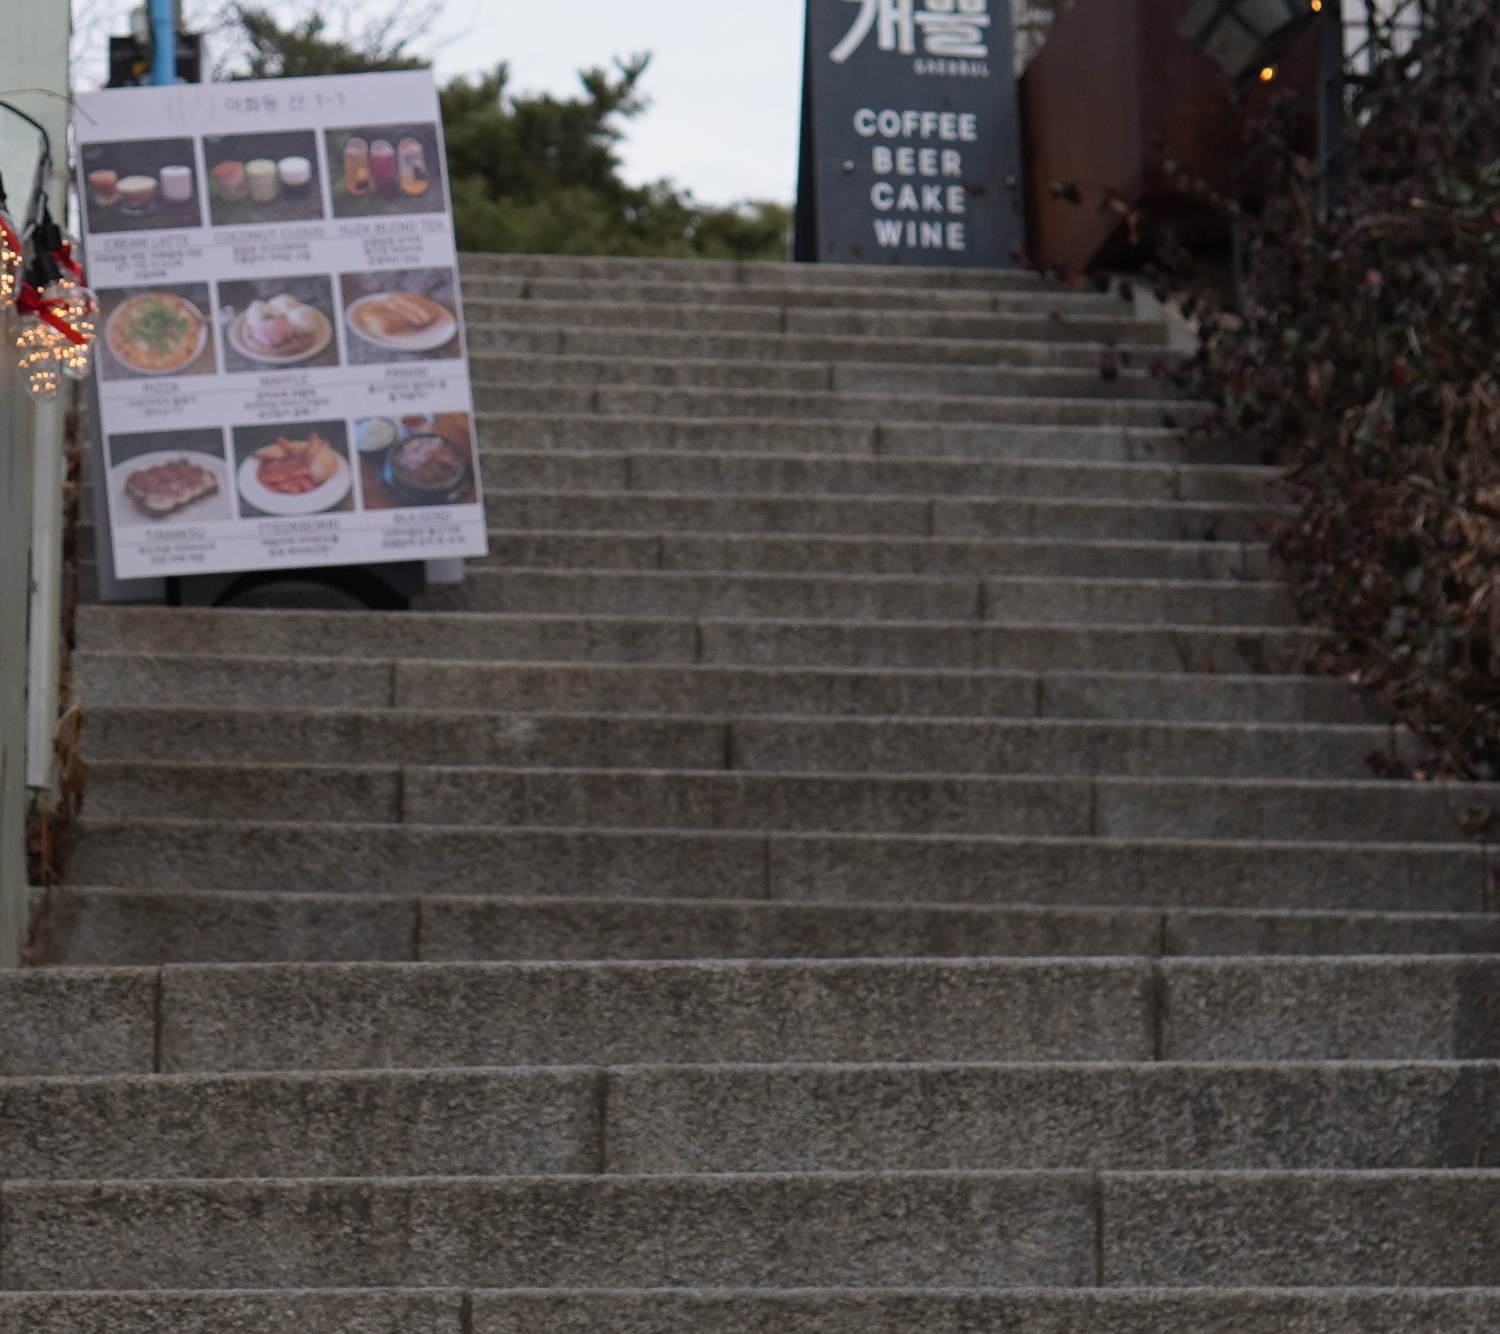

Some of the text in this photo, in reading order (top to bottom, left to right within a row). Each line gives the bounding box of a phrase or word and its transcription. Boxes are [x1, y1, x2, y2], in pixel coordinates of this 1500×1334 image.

[854, 108, 977, 142] COFFEE
[872, 146, 962, 177] BEER
[871, 182, 966, 213] CAKE
[875, 218, 967, 251] WINE
